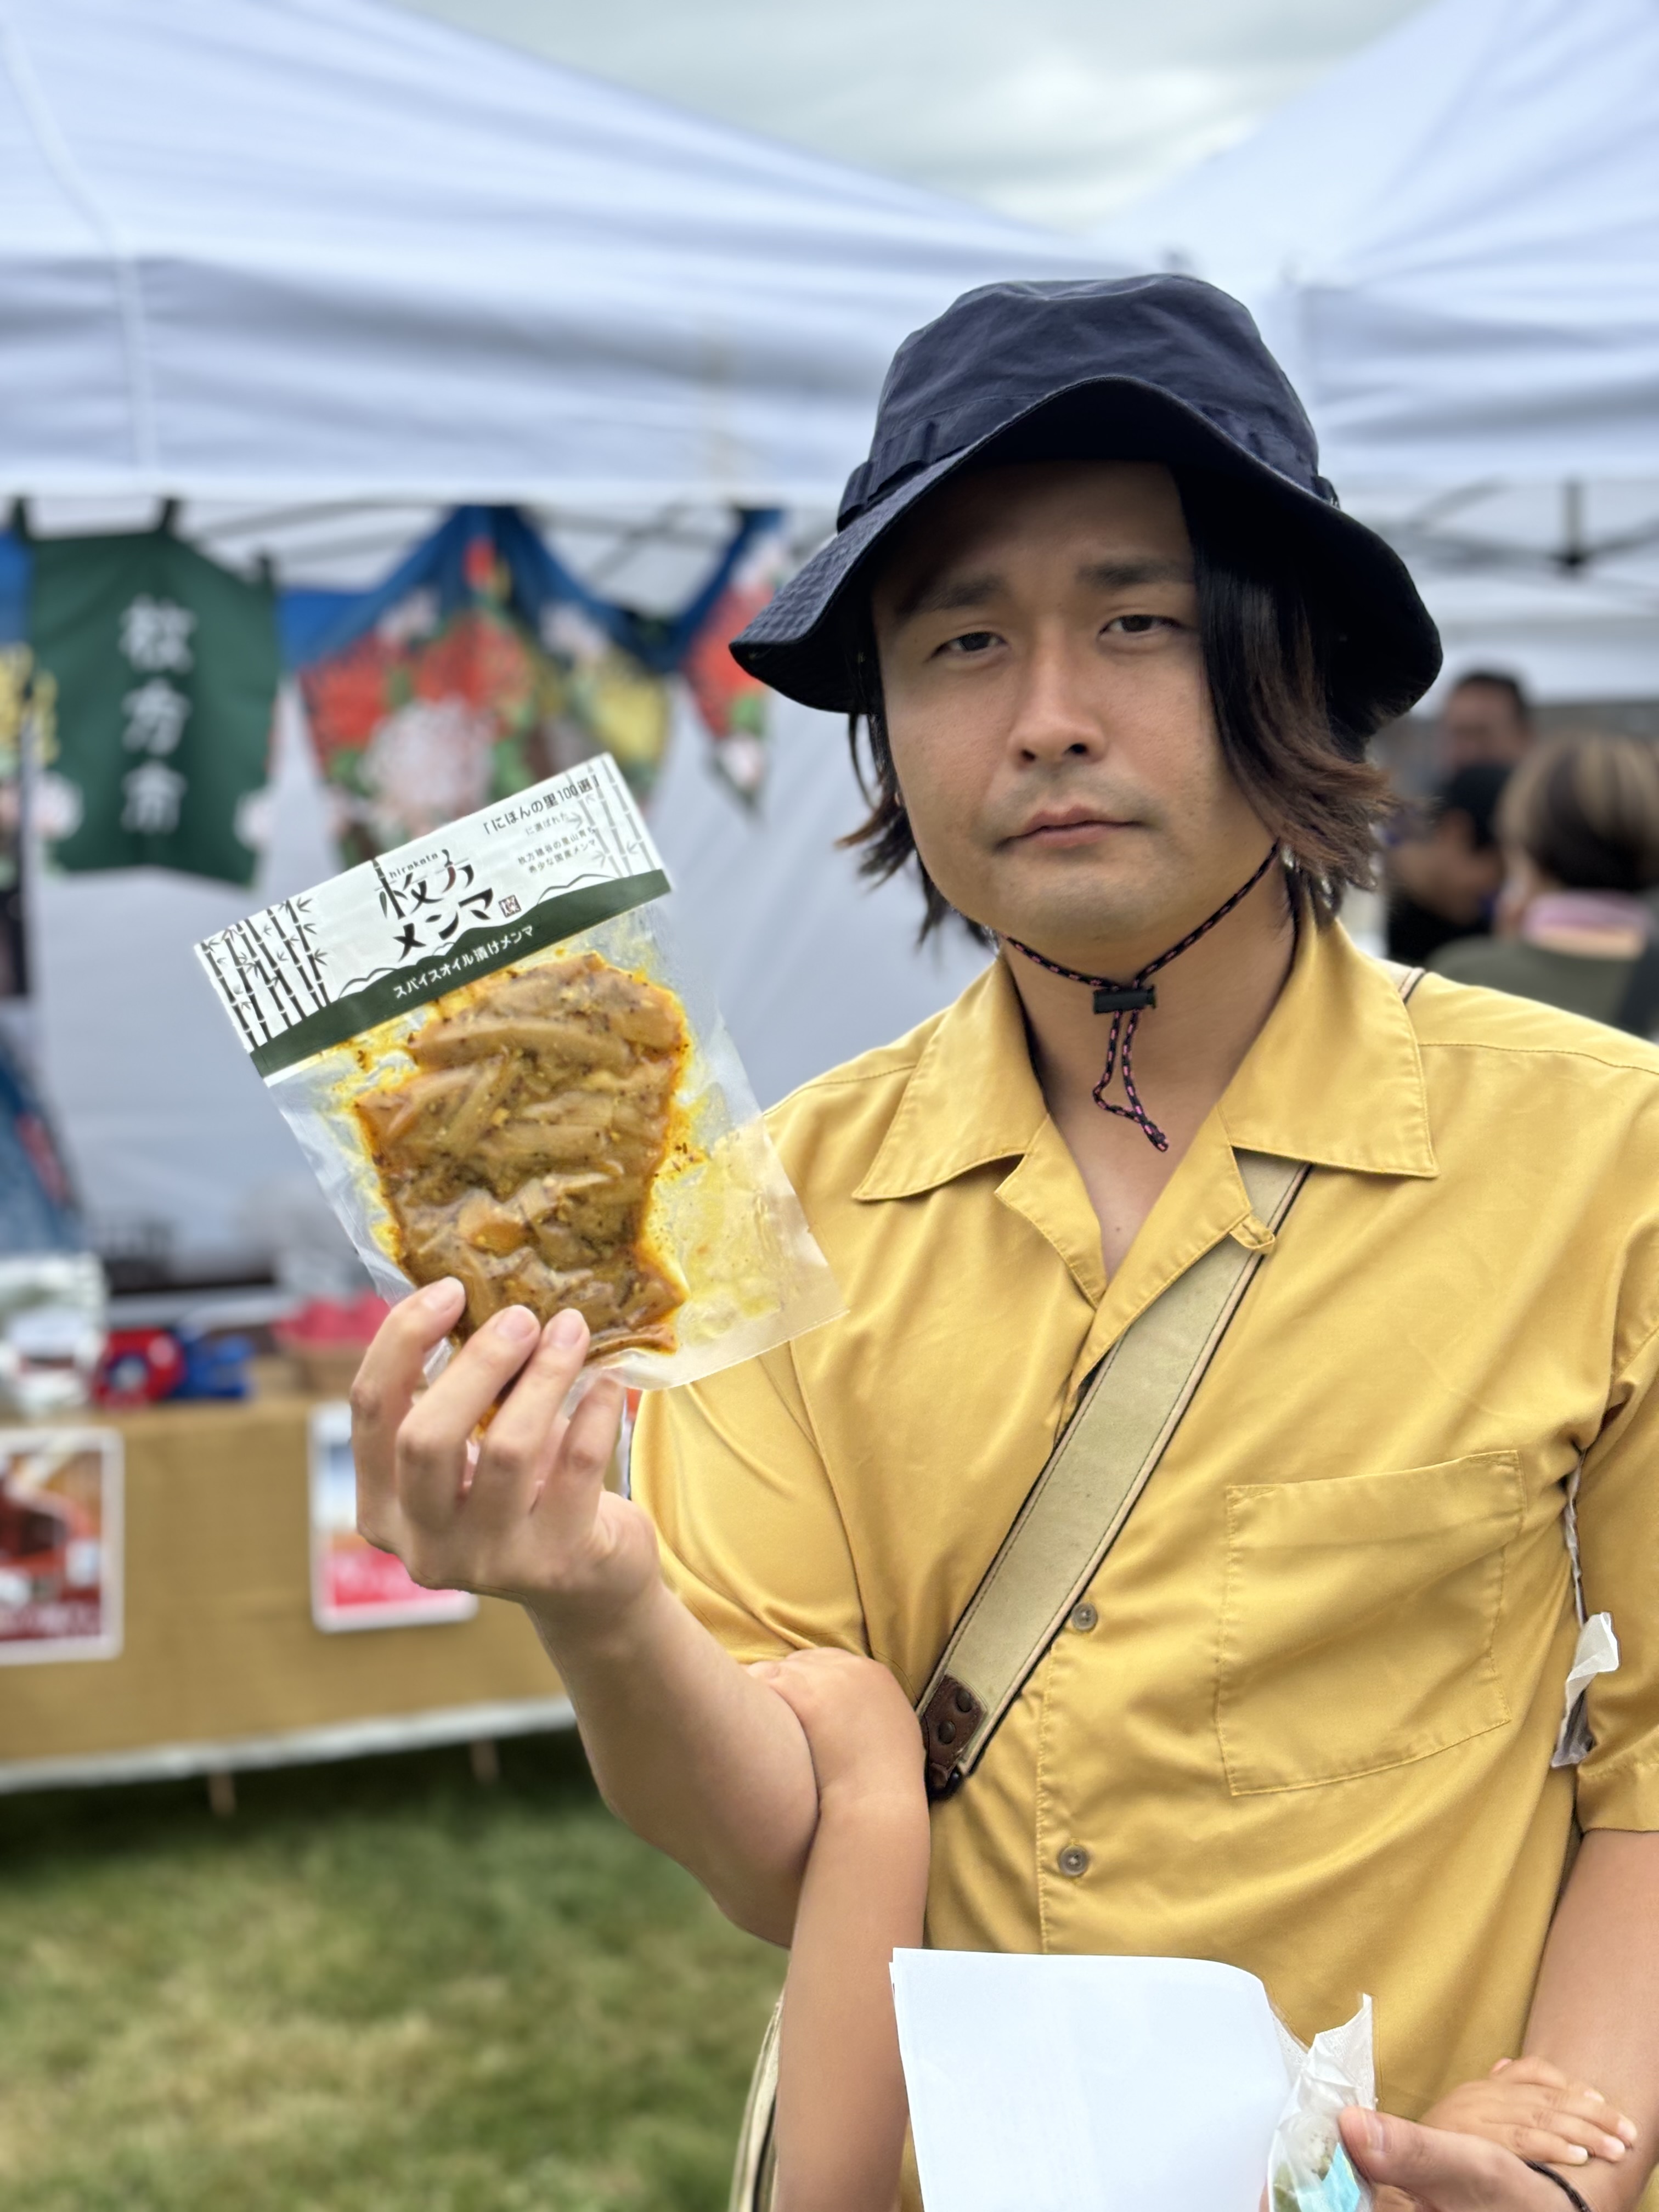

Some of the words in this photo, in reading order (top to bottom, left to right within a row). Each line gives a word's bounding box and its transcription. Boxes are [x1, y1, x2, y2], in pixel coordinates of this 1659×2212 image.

[374, 849, 475, 920] 枚方
[388, 852, 439, 879] hirakata
[392, 887, 493, 962] メンマ
[393, 924, 533, 999] スパイスオイル漬けメンマ
